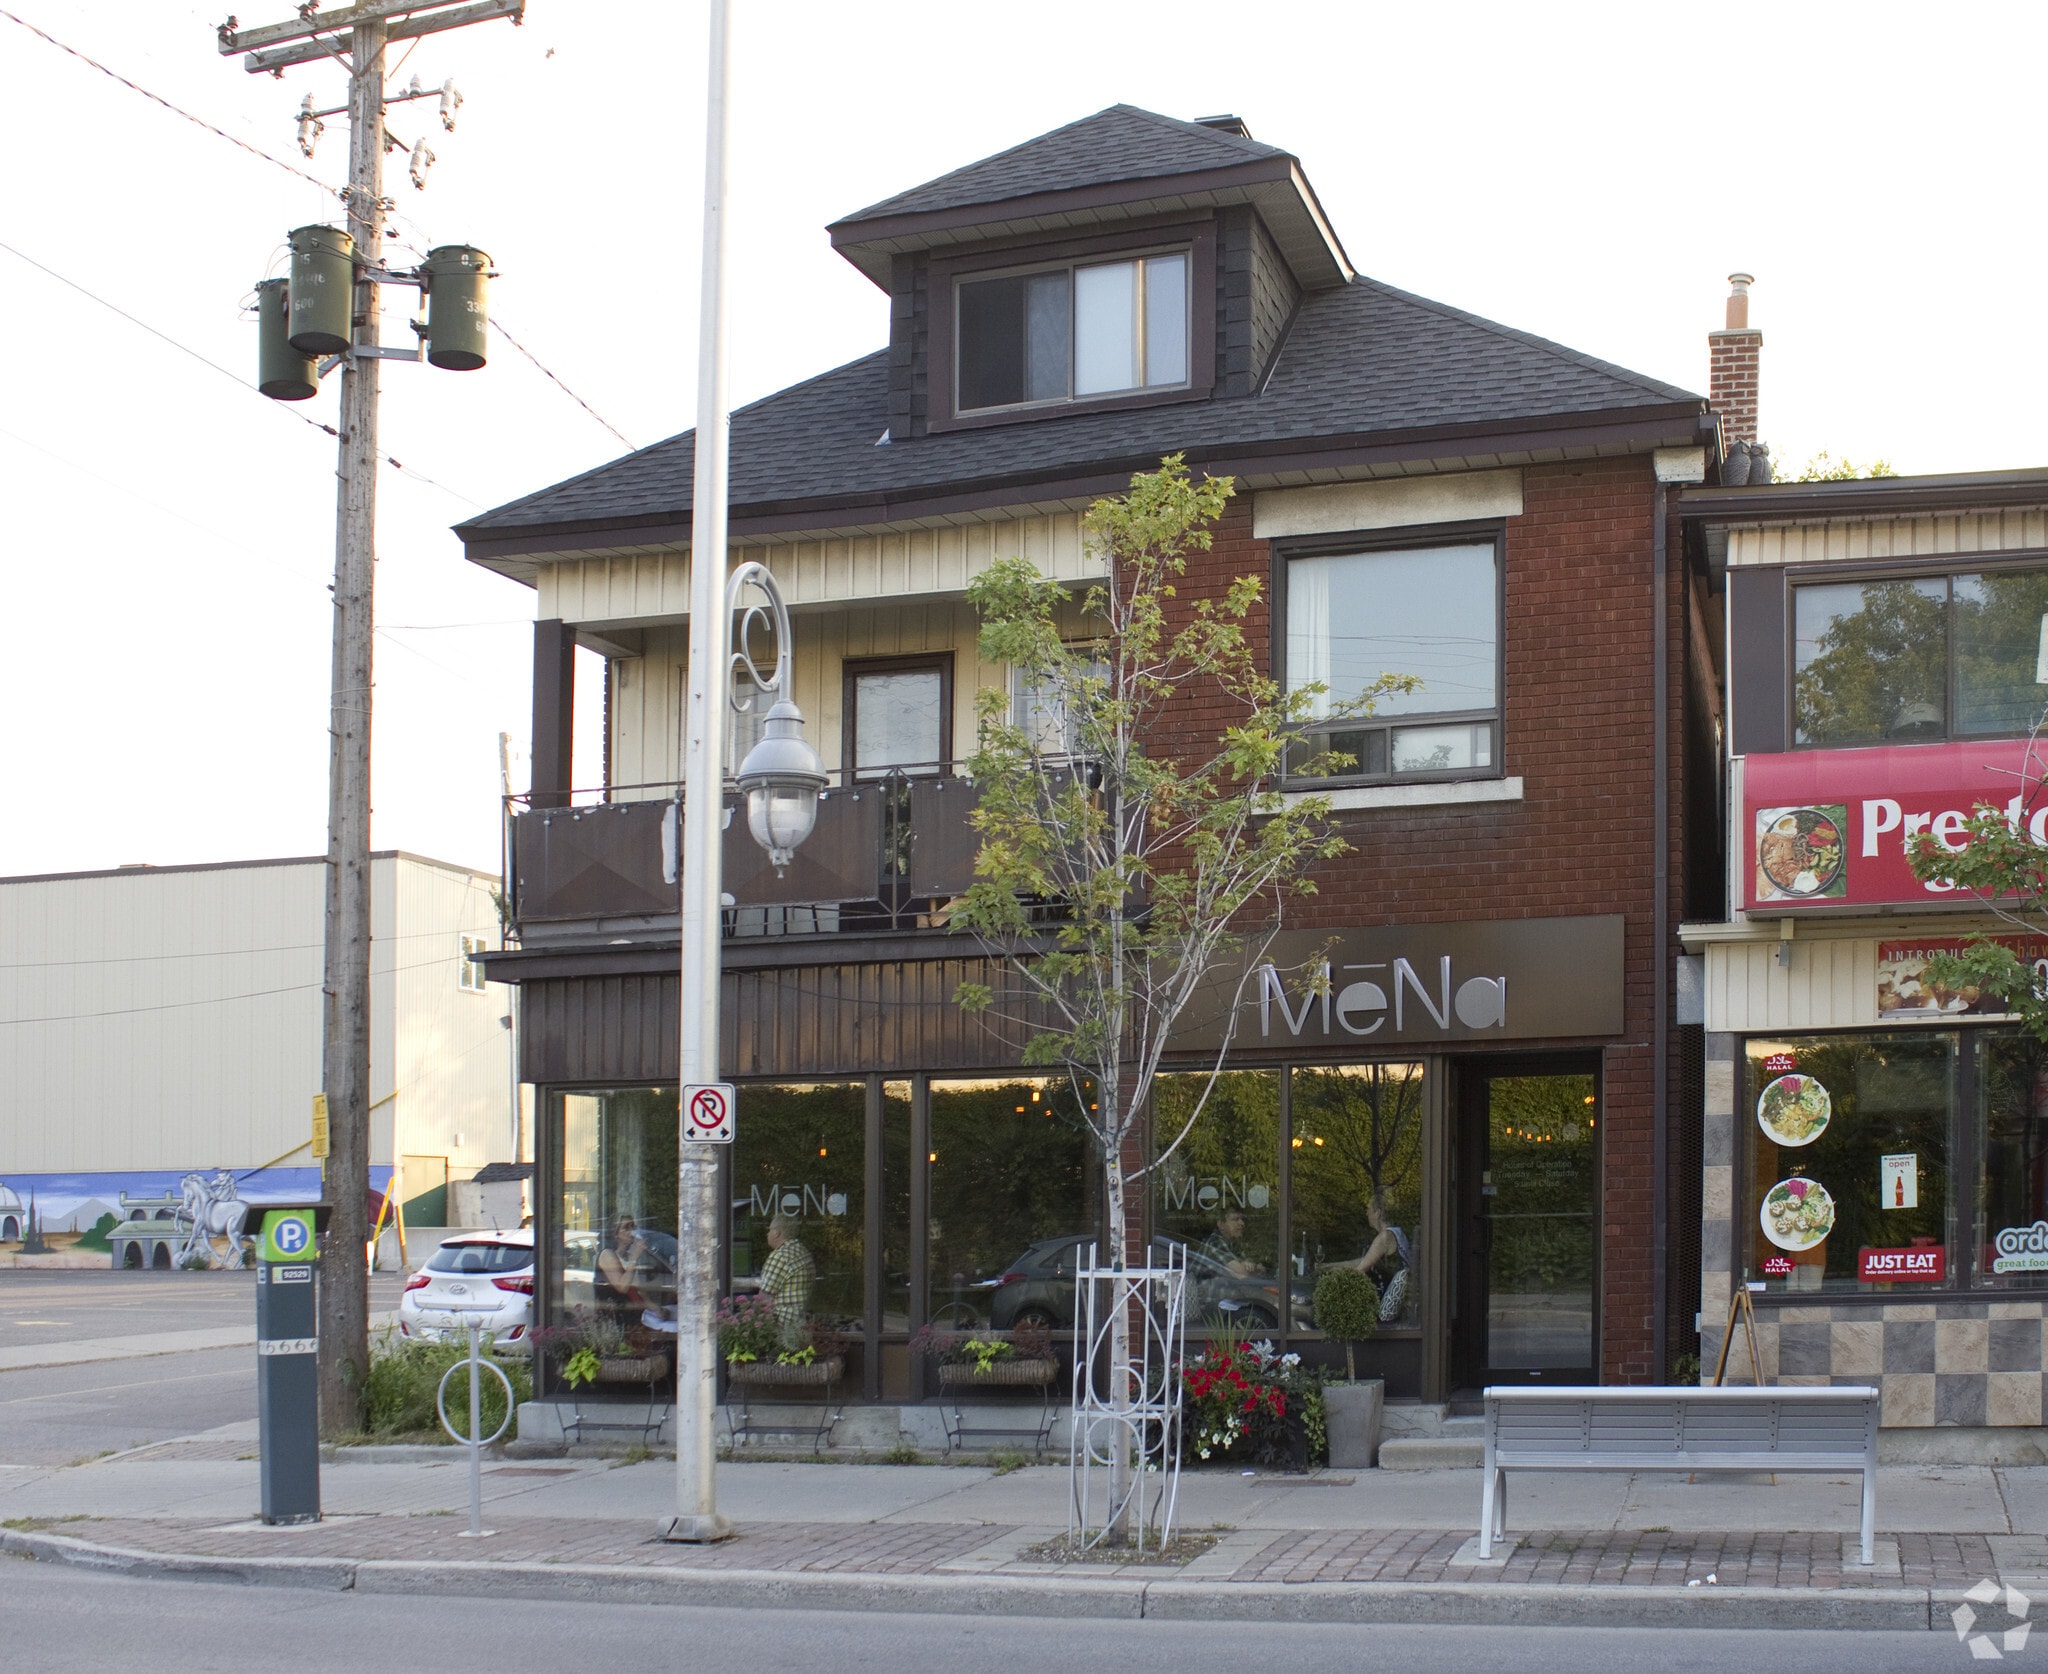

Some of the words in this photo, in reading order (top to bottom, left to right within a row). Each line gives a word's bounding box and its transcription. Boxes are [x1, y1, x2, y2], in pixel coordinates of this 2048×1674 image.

[1865, 1254, 1904, 1269] JUST
[1906, 1253, 1936, 1268] EAT
[1997, 1260, 2025, 1269] great
[2029, 1258, 2048, 1267] foo
